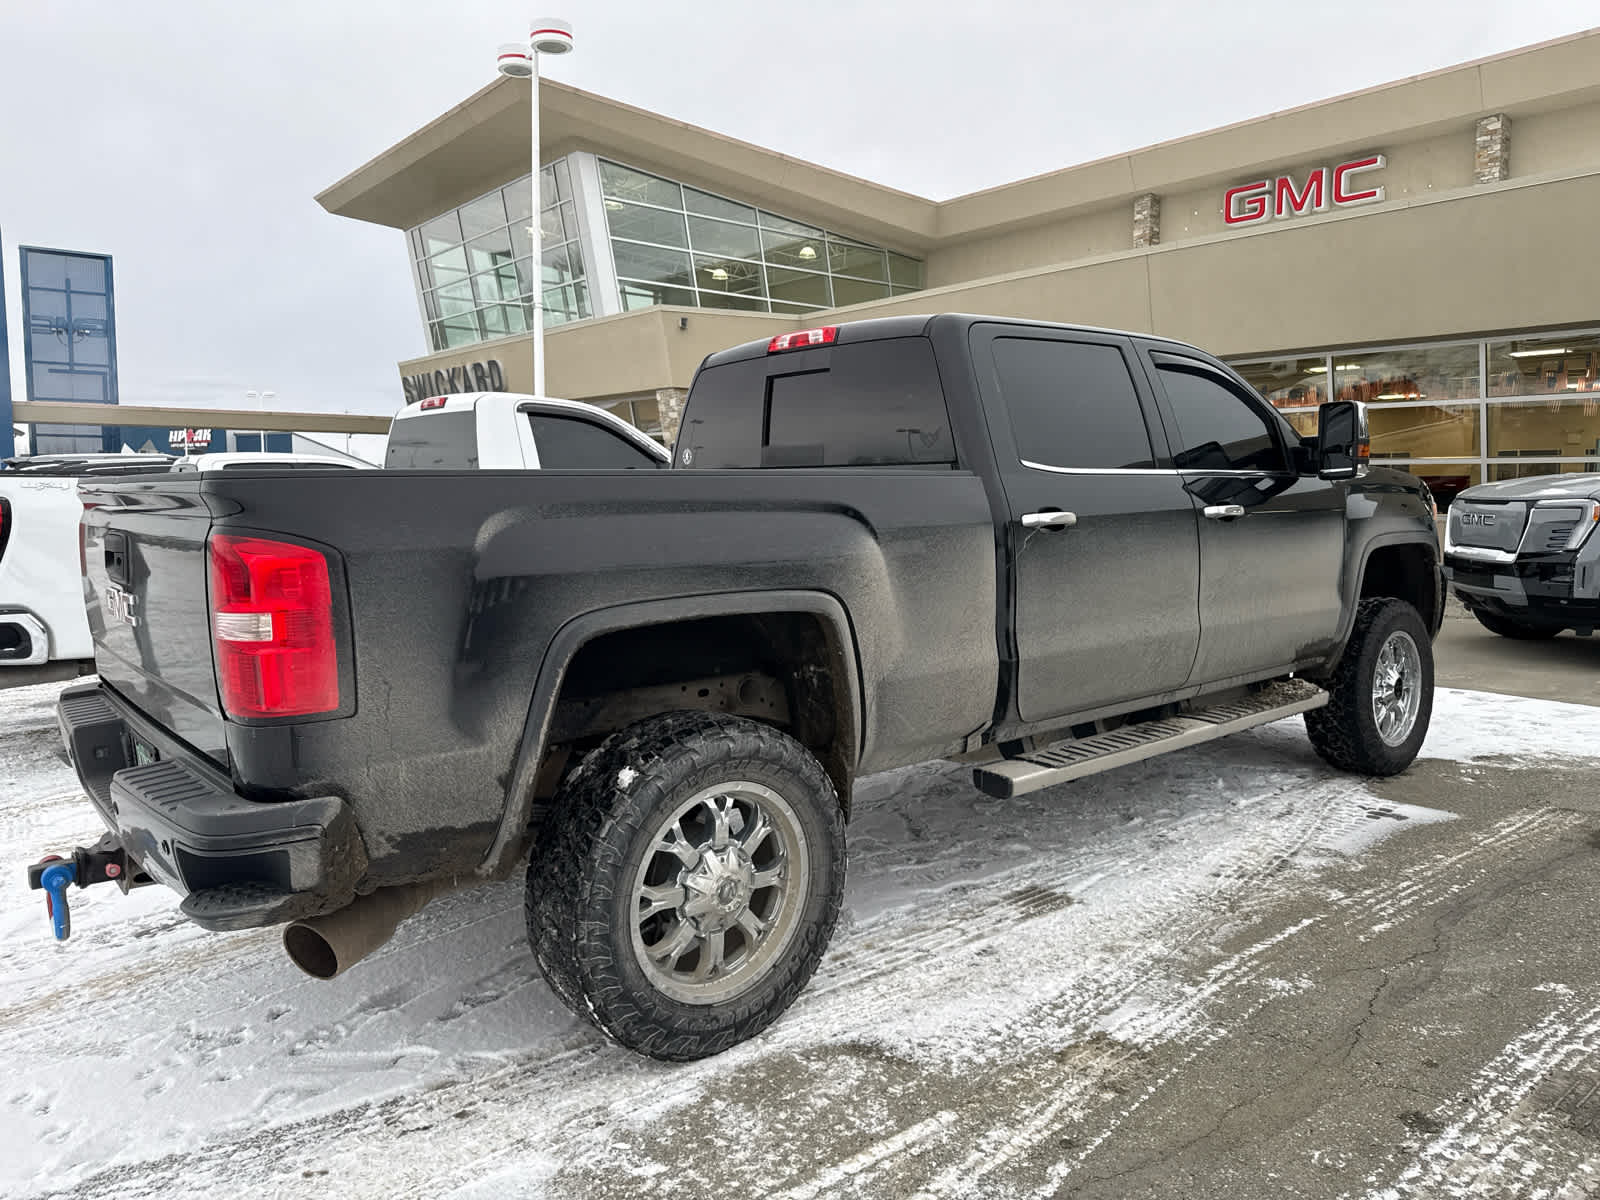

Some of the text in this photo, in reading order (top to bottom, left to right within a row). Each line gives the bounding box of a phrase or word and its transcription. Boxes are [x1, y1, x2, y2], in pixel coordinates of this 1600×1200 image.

[1224, 155, 1386, 227] GMC
[402, 360, 504, 405] SWICKARD
[1462, 513, 1496, 526] GMC
[106, 587, 138, 627] GMC
